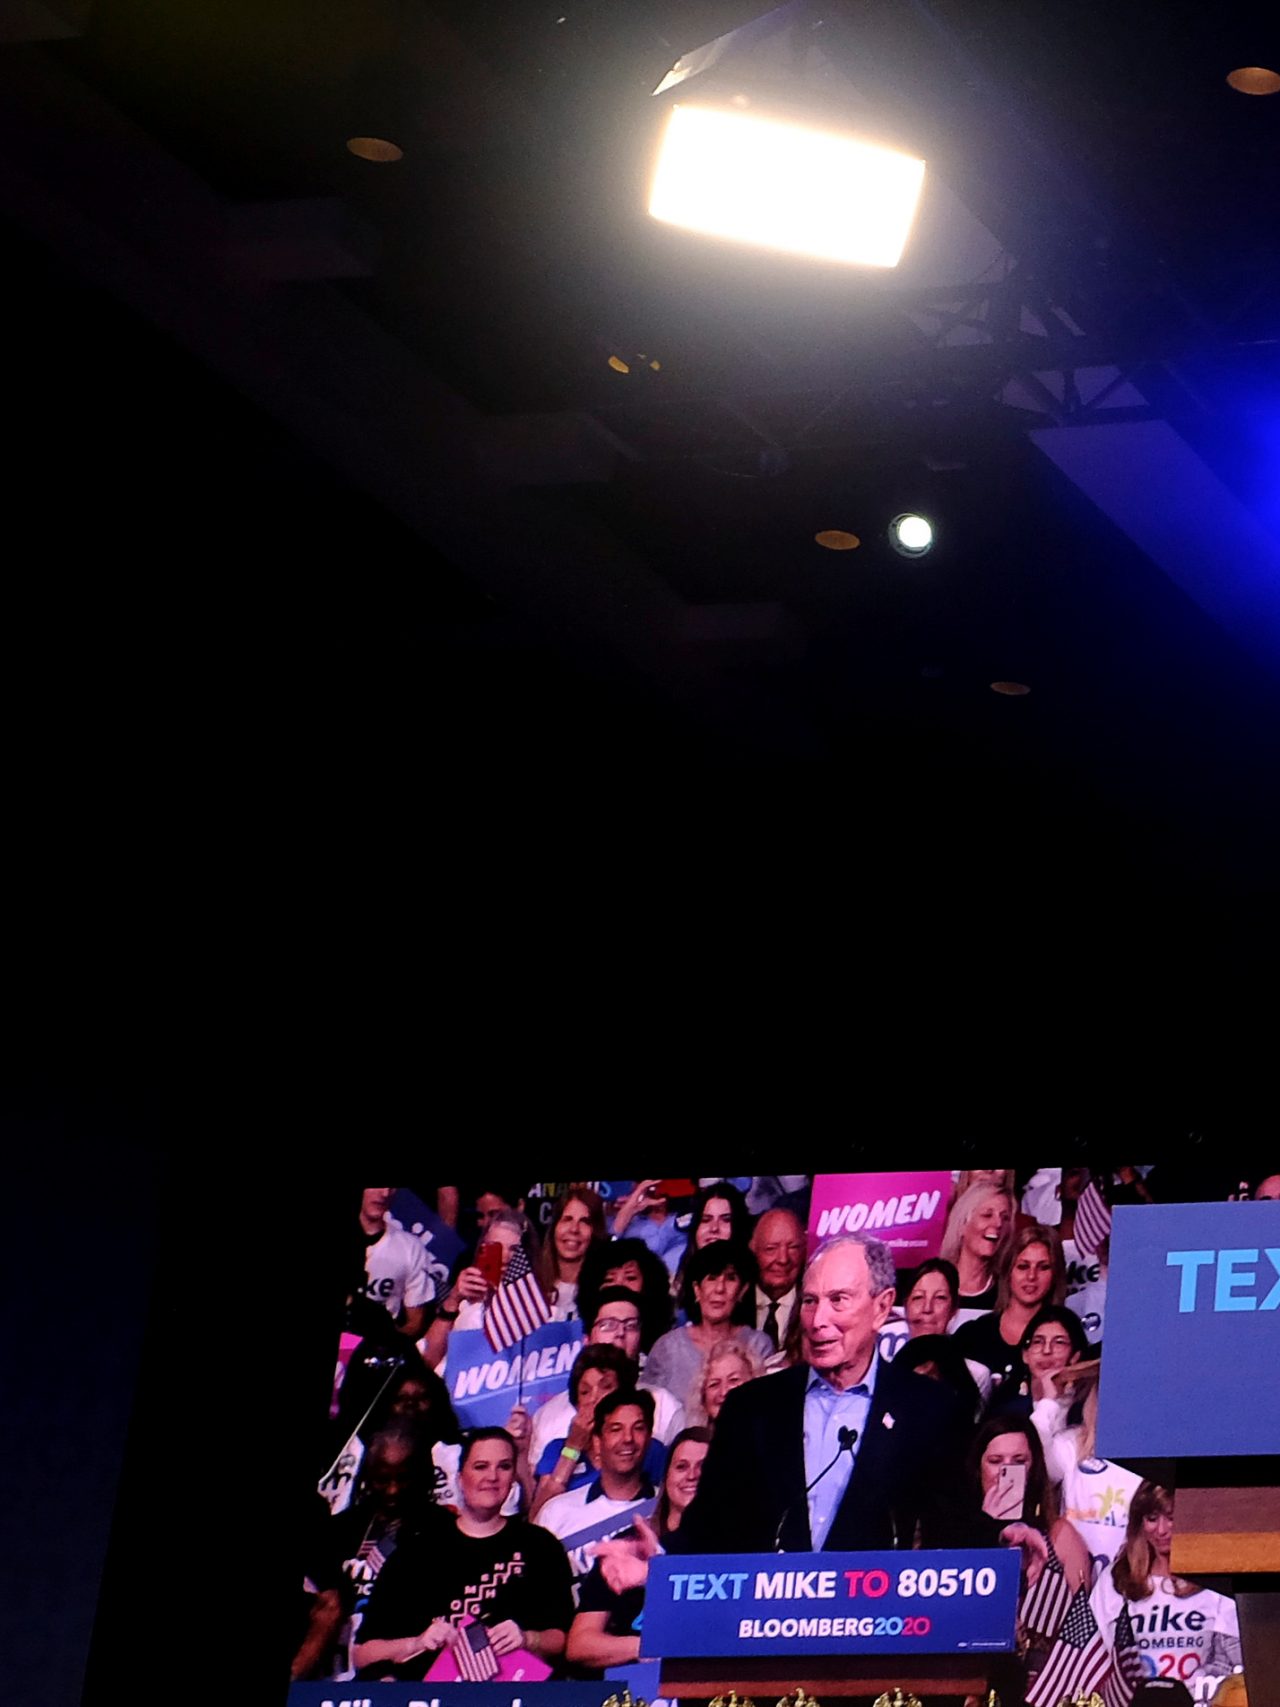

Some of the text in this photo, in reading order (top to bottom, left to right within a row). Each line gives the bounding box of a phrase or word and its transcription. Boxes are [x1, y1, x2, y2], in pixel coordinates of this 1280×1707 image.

[816, 1190, 941, 1237] WOMEN
[454, 1340, 582, 1399] WOMEN
[668, 1567, 997, 1601] TEXT MIKE TO 80510
[738, 1616, 931, 1639] BLOOMBERG2020
[1138, 1635, 1206, 1650] OMBERG
